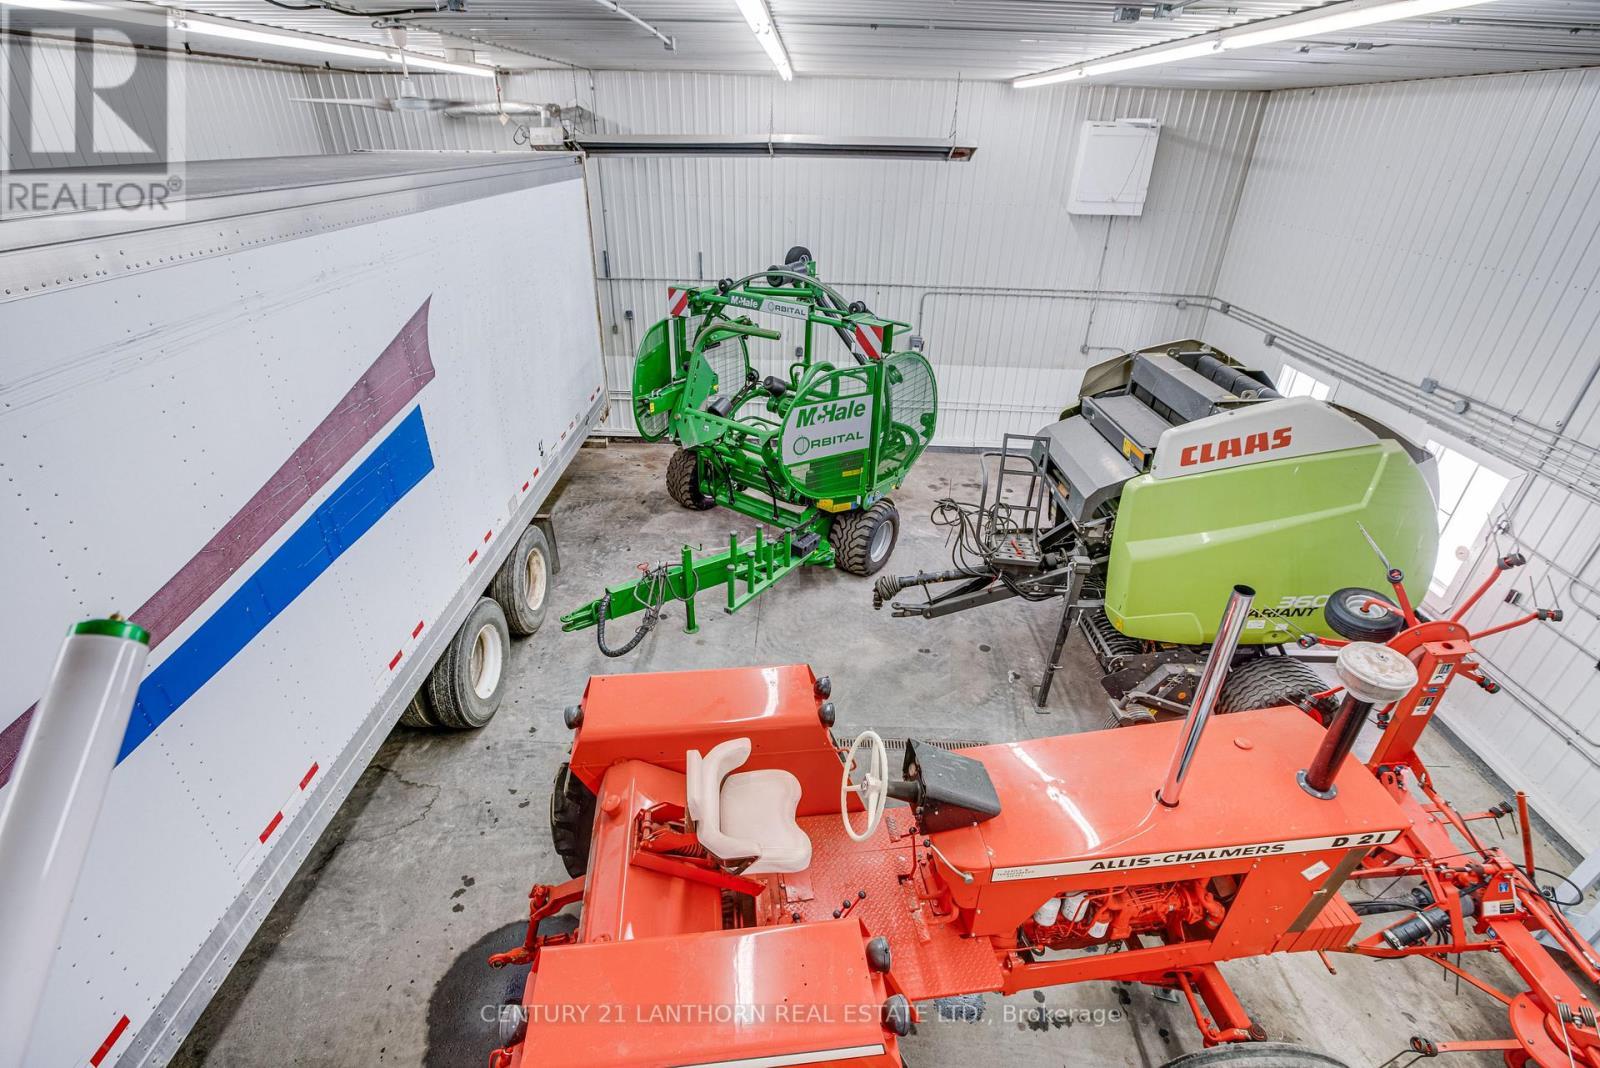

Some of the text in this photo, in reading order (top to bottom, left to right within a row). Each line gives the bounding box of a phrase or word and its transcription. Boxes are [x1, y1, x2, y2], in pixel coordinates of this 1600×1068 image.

[767, 301, 806, 316] ORBITAL
[793, 431, 864, 456] ORBITAL
[1180, 427, 1292, 467] CLAAS
[1277, 594, 1331, 609] 360
[1247, 607, 1319, 618] ARIANT
[1089, 832, 1387, 872] ALLIS-CHALMERS D 21
